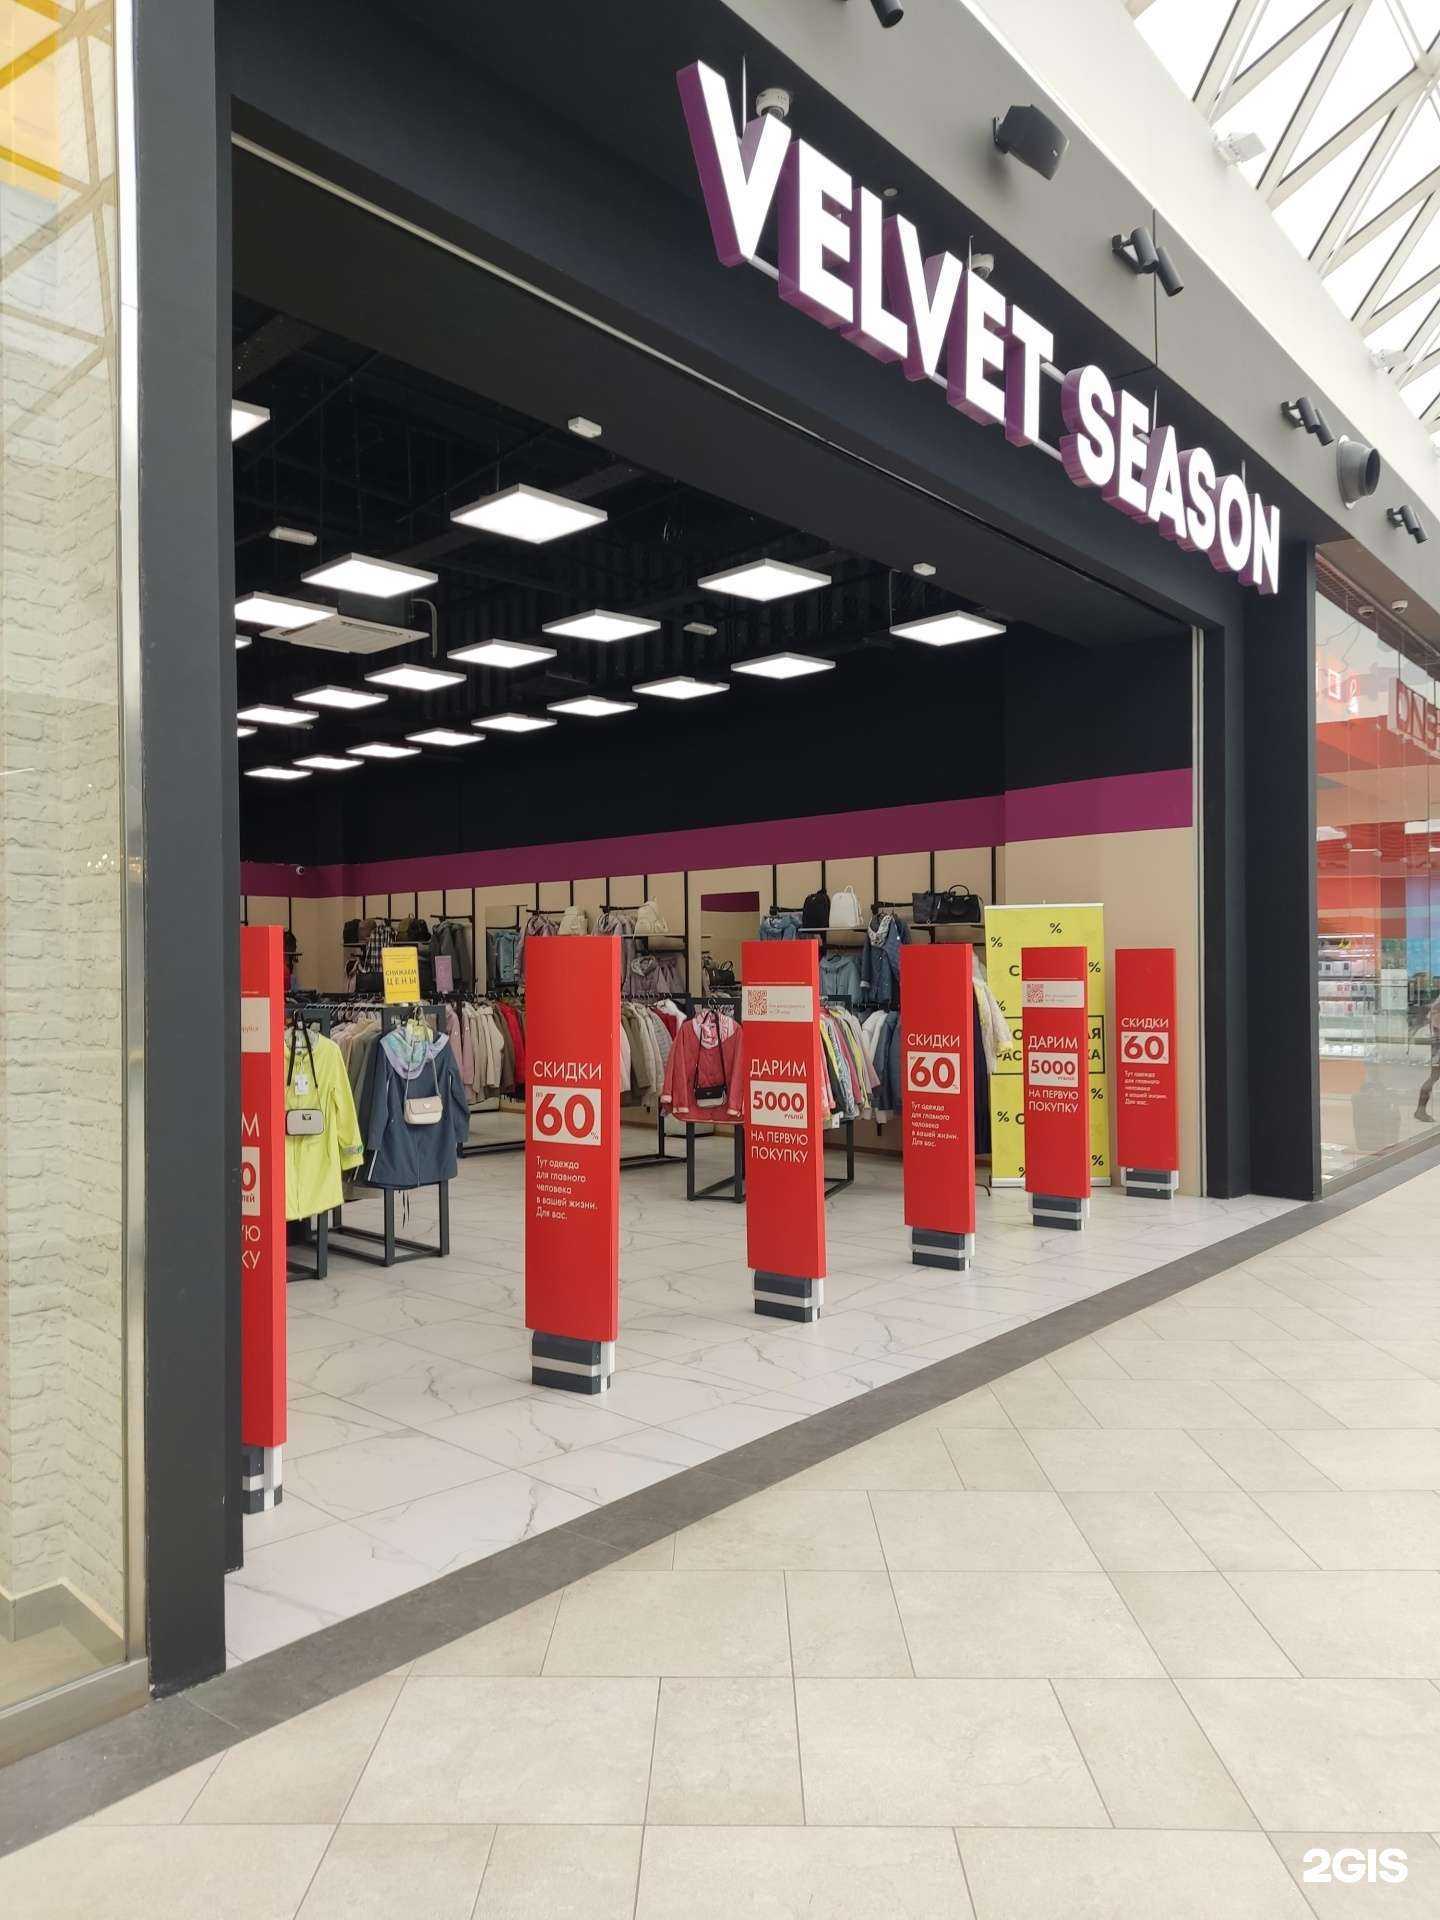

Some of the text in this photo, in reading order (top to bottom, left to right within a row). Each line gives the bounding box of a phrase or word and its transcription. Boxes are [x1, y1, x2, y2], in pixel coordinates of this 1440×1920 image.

[680, 60, 1281, 594] VELVET SEASON
[1121, 1017, 1169, 1029] СКИДКИ
[907, 1033, 960, 1049] СКИДКИ
[1028, 1035, 1078, 1050] ДАРИМ
[533, 1060, 602, 1083] СКИДКИ
[750, 1058, 807, 1078] ДАРИМ
[1030, 1059, 1076, 1076] 5000
[752, 1090, 805, 1113] 5000
[1028, 1089, 1079, 1101] НА ПЕРВУЮ
[1028, 1100, 1079, 1114] ПОКУПКУ
[751, 1130, 808, 1146] НА ПЕРВУЮ
[751, 1145, 808, 1163] ПОКУПКУ
[536, 1155, 548, 1169] Тут
[536, 1171, 586, 1183] для главного
[542, 1197, 567, 1207] вашей
[536, 1206, 550, 1219] Для
